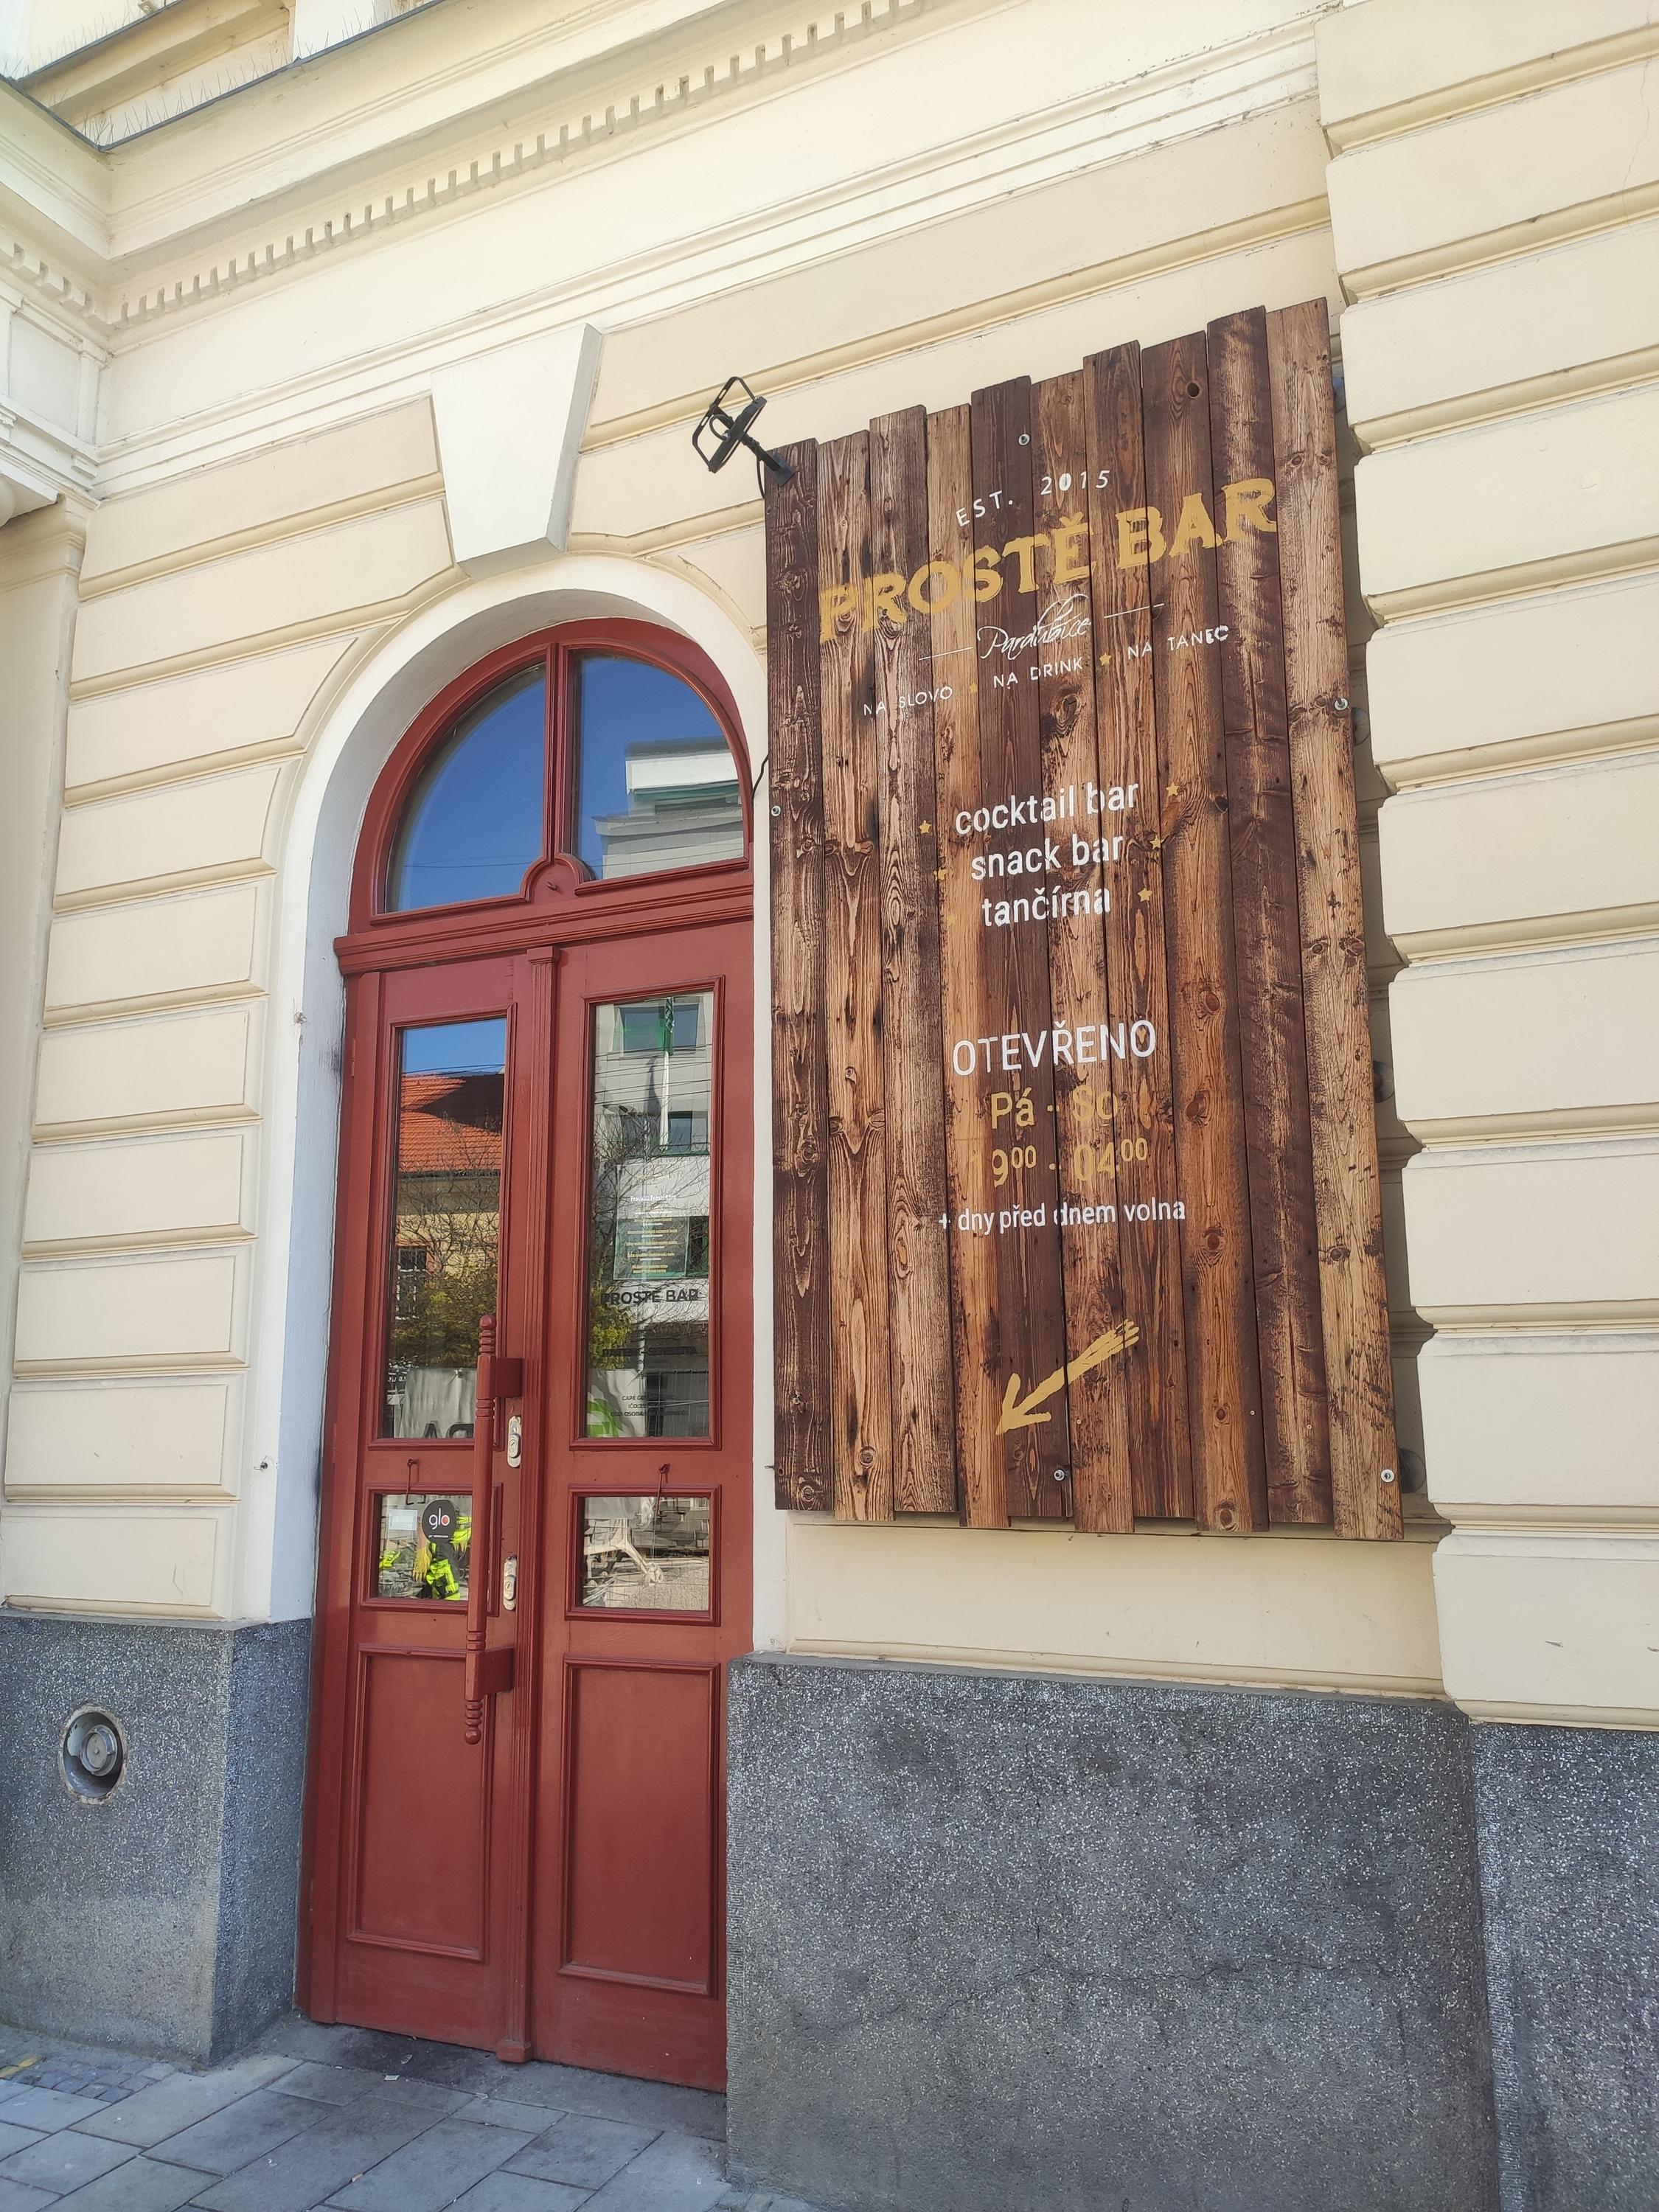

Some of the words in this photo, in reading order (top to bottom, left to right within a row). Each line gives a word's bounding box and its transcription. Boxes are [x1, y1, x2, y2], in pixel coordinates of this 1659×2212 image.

[956, 490, 1013, 526] EST.
[1040, 470, 1110, 495] 2015
[819, 512, 1099, 645] PROSTĚ
[1115, 477, 1278, 571] BAR
[976, 593, 1092, 661] Pardubice
[863, 701, 887, 716] NA
[898, 686, 953, 709] SLOVO
[993, 672, 1018, 689] NA
[1030, 657, 1083, 681] DRINK
[1127, 642, 1152, 661] NA
[1168, 625, 1230, 652] TANEC
[956, 785, 1074, 835] cocktail
[1087, 782, 1139, 815] bar
[971, 837, 1061, 881] snack
[1072, 833, 1124, 867] bar
[981, 886, 1111, 928] tančírna
[953, 1020, 1157, 1077] OTEVŘENO
[990, 1087, 1035, 1130] Pá
[1071, 1085, 1119, 1122] So
[958, 1208, 995, 1236] dny
[999, 1203, 1046, 1234] před
[1054, 1202, 1116, 1226] dnem
[1123, 1197, 1186, 1222] volna
[666, 1288, 699, 1302] BAR
[428, 1508, 451, 1530] glo
